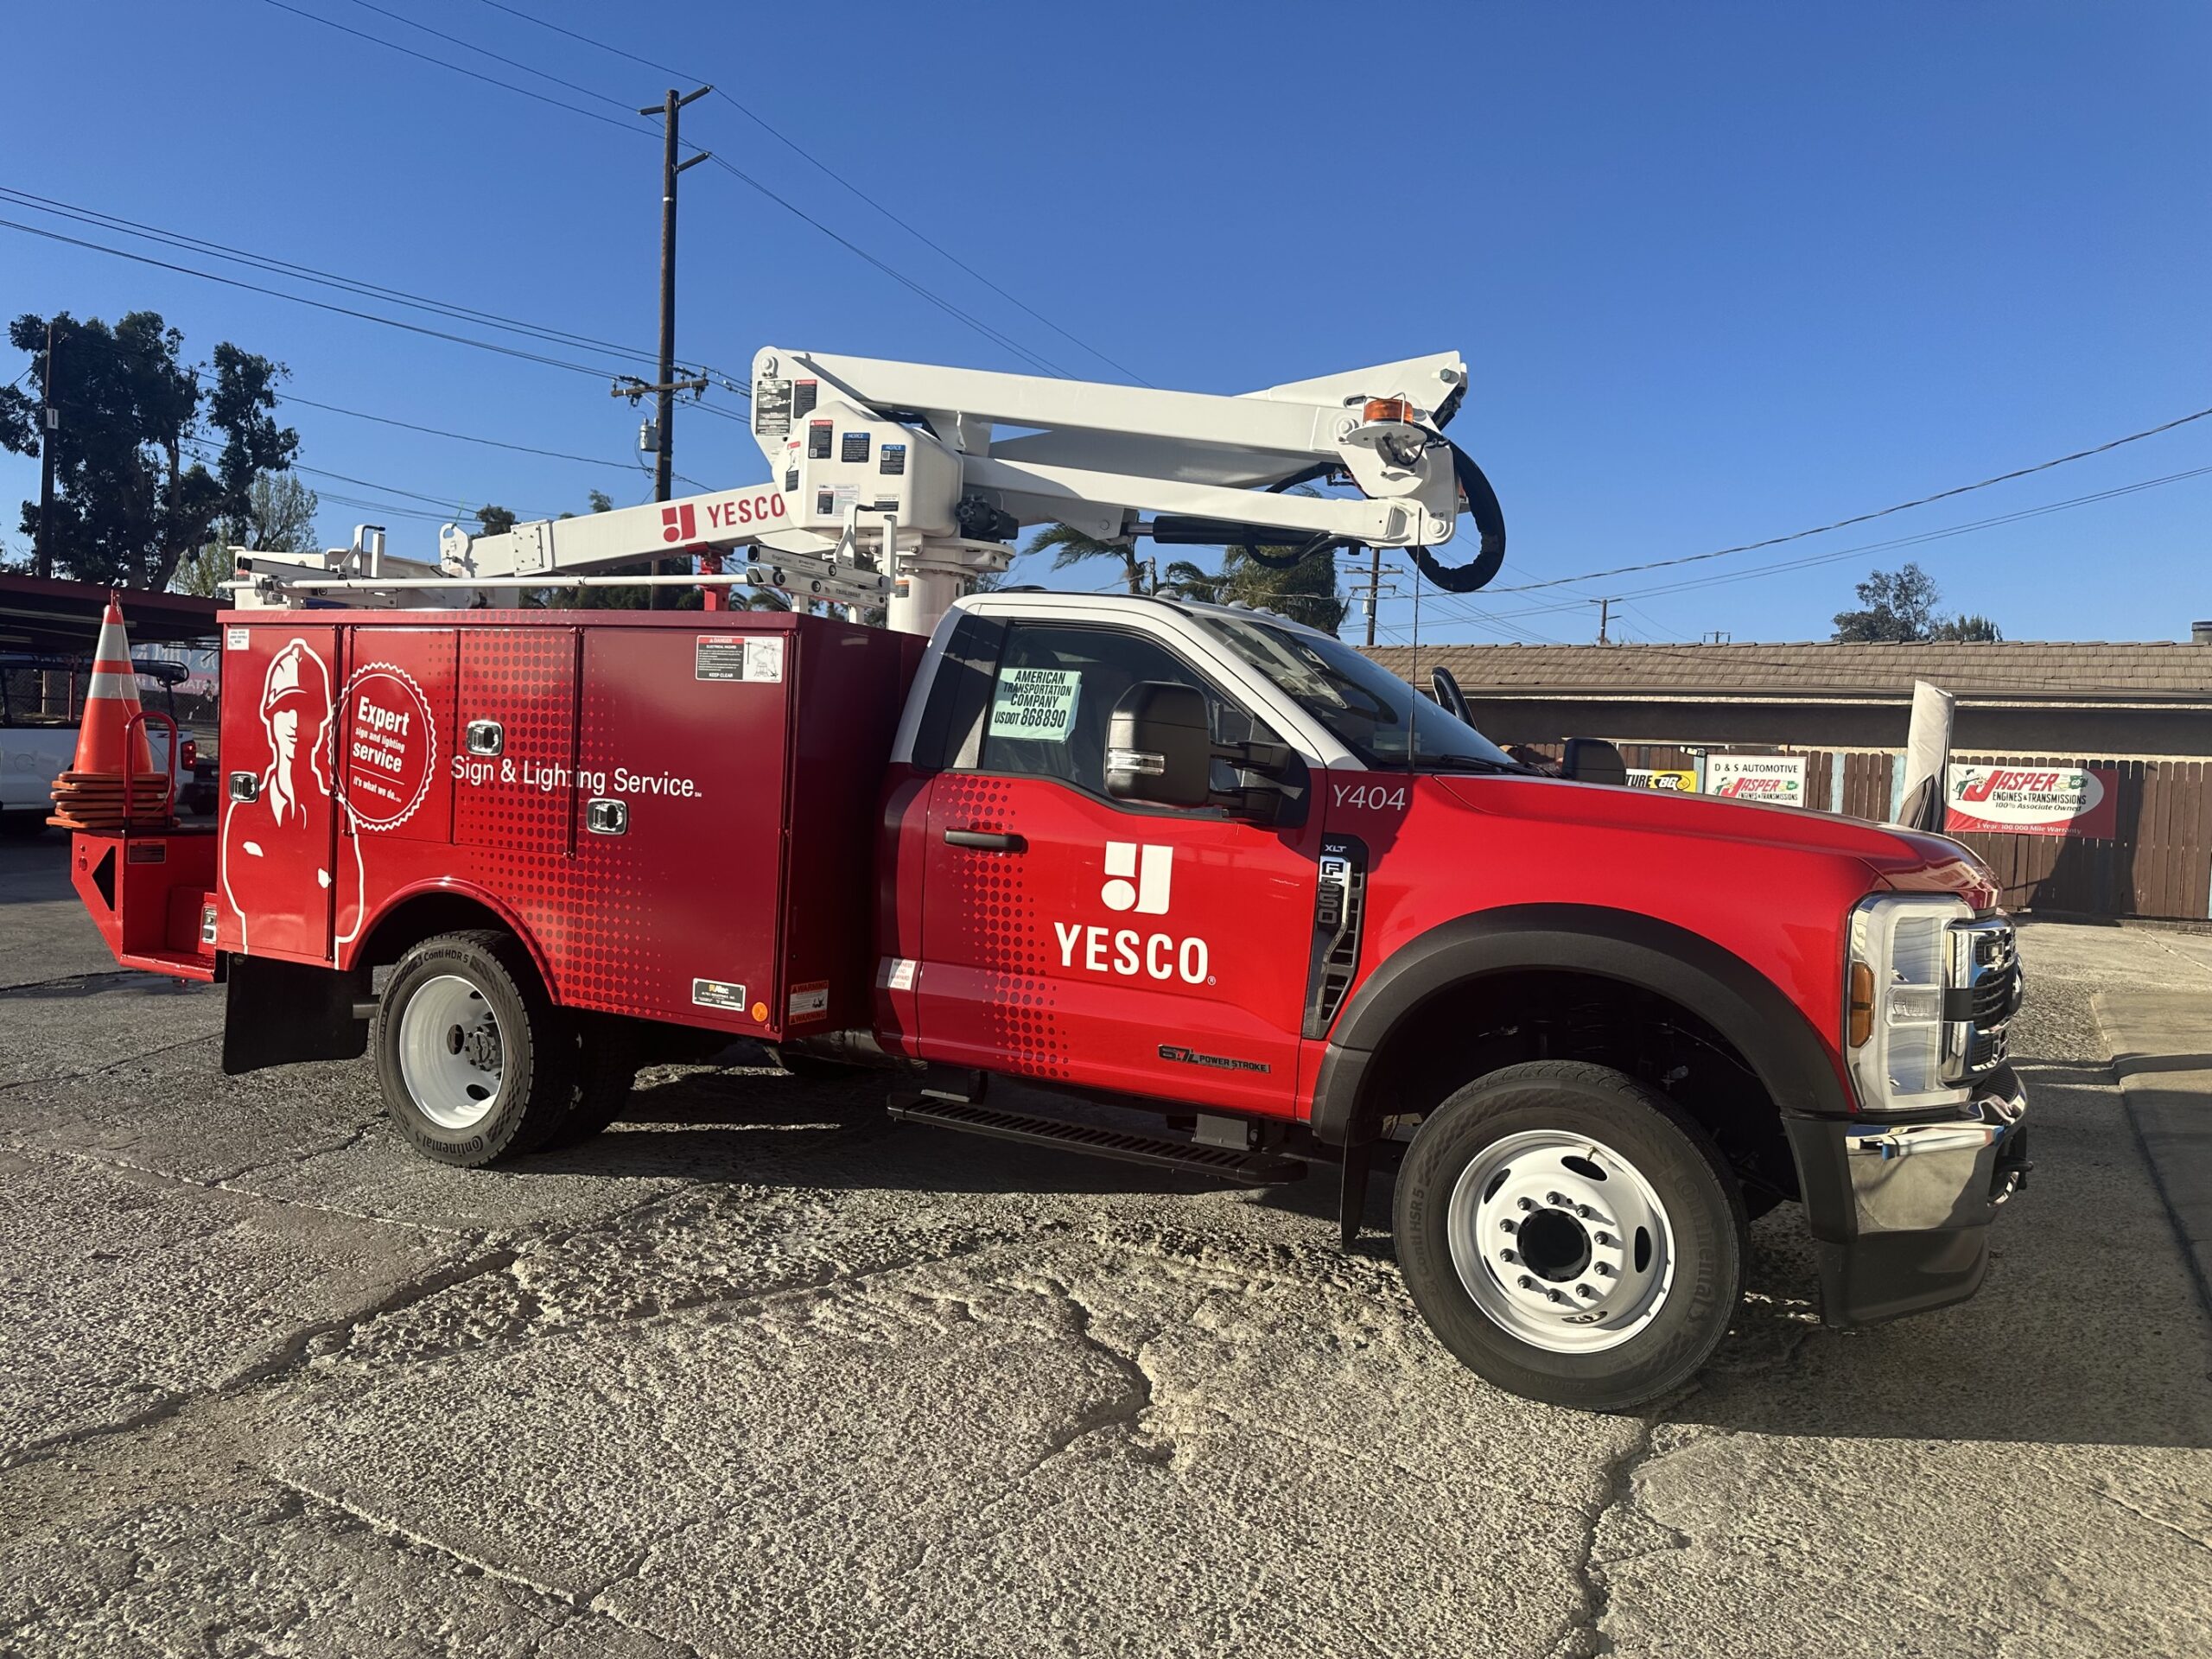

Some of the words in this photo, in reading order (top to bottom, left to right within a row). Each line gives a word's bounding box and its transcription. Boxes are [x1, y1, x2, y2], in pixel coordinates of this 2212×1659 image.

[707, 493, 785, 528] YESCO
[1014, 671, 1065, 684] AMERICAN
[1003, 683, 1071, 696] TRANSPORTATION
[1011, 693, 1059, 709] COMPANY
[358, 696, 410, 736] Expert
[995, 711, 1020, 725] USDOT
[1020, 708, 1066, 728] 868890
[355, 727, 368, 739] sign
[369, 732, 381, 743] and
[381, 734, 405, 753] lighting
[353, 742, 403, 772] service
[451, 755, 494, 786] Sign
[500, 758, 517, 783] &
[614, 767, 694, 798] Service
[1714, 763, 1720, 772] D
[1725, 763, 1730, 772] &
[1742, 764, 1798, 773] AUTOMOTIVE
[363, 781, 377, 793] what
[378, 785, 386, 795] we
[1659, 777, 1678, 791] BG
[1720, 777, 1782, 798] JASPER
[1962, 770, 2060, 802] JASPER
[1333, 785, 1406, 810] Y404
[1761, 792, 1798, 801] TRANSMISSIONS
[1993, 791, 2022, 802] ENGINES
[2028, 792, 2087, 805] TRANSMISSIONS
[2047, 826, 2082, 836] Warranty
[1325, 844, 1347, 853] XLT
[445, 950, 462, 961] HDR
[1159, 1045, 1198, 1064] 6.7L
[1199, 1055, 1230, 1066] POWER
[1231, 1059, 1267, 1072] STROKE
[423, 1135, 484, 1157] Continental
